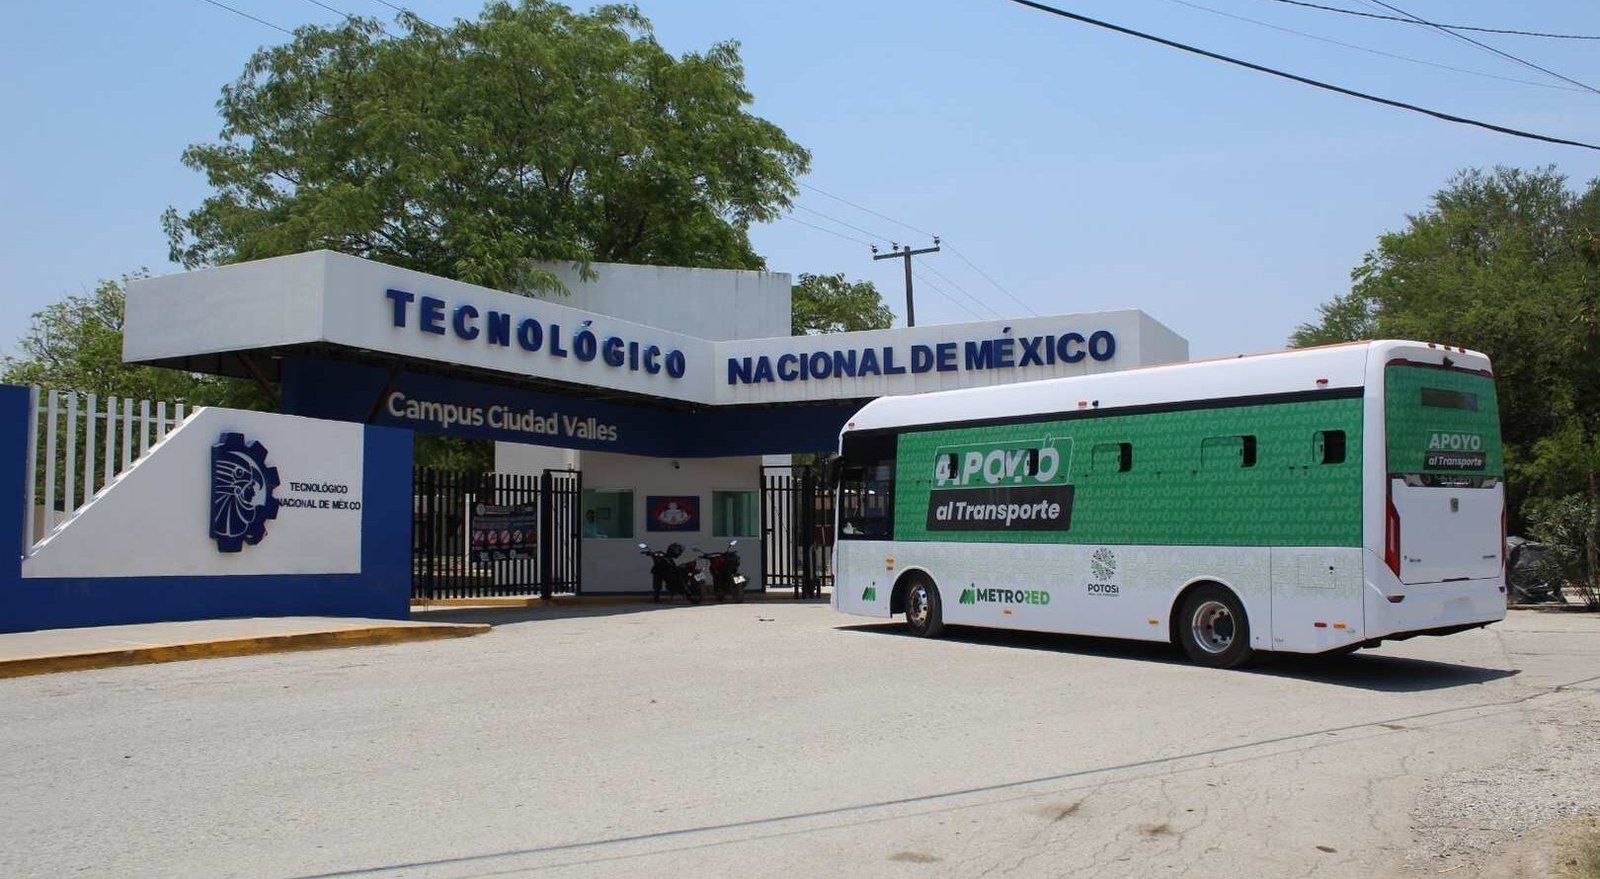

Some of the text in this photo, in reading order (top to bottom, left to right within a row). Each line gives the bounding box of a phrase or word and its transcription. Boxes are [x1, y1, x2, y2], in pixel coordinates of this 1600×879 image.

[386, 289, 686, 379] TECNOLÓGICO
[727, 326, 1116, 385] NACIONAL DE MÉXICO
[388, 392, 618, 441] Campus Ciudad Valles
[1429, 432, 1481, 450] APOYO
[1439, 456, 1482, 468] Transporte
[290, 481, 348, 494] TECNOLÓGICO
[278, 498, 317, 509] NACIONAL
[319, 500, 330, 509] DE
[936, 500, 1060, 526] al Transporte
[976, 588, 1050, 605] METRORED
